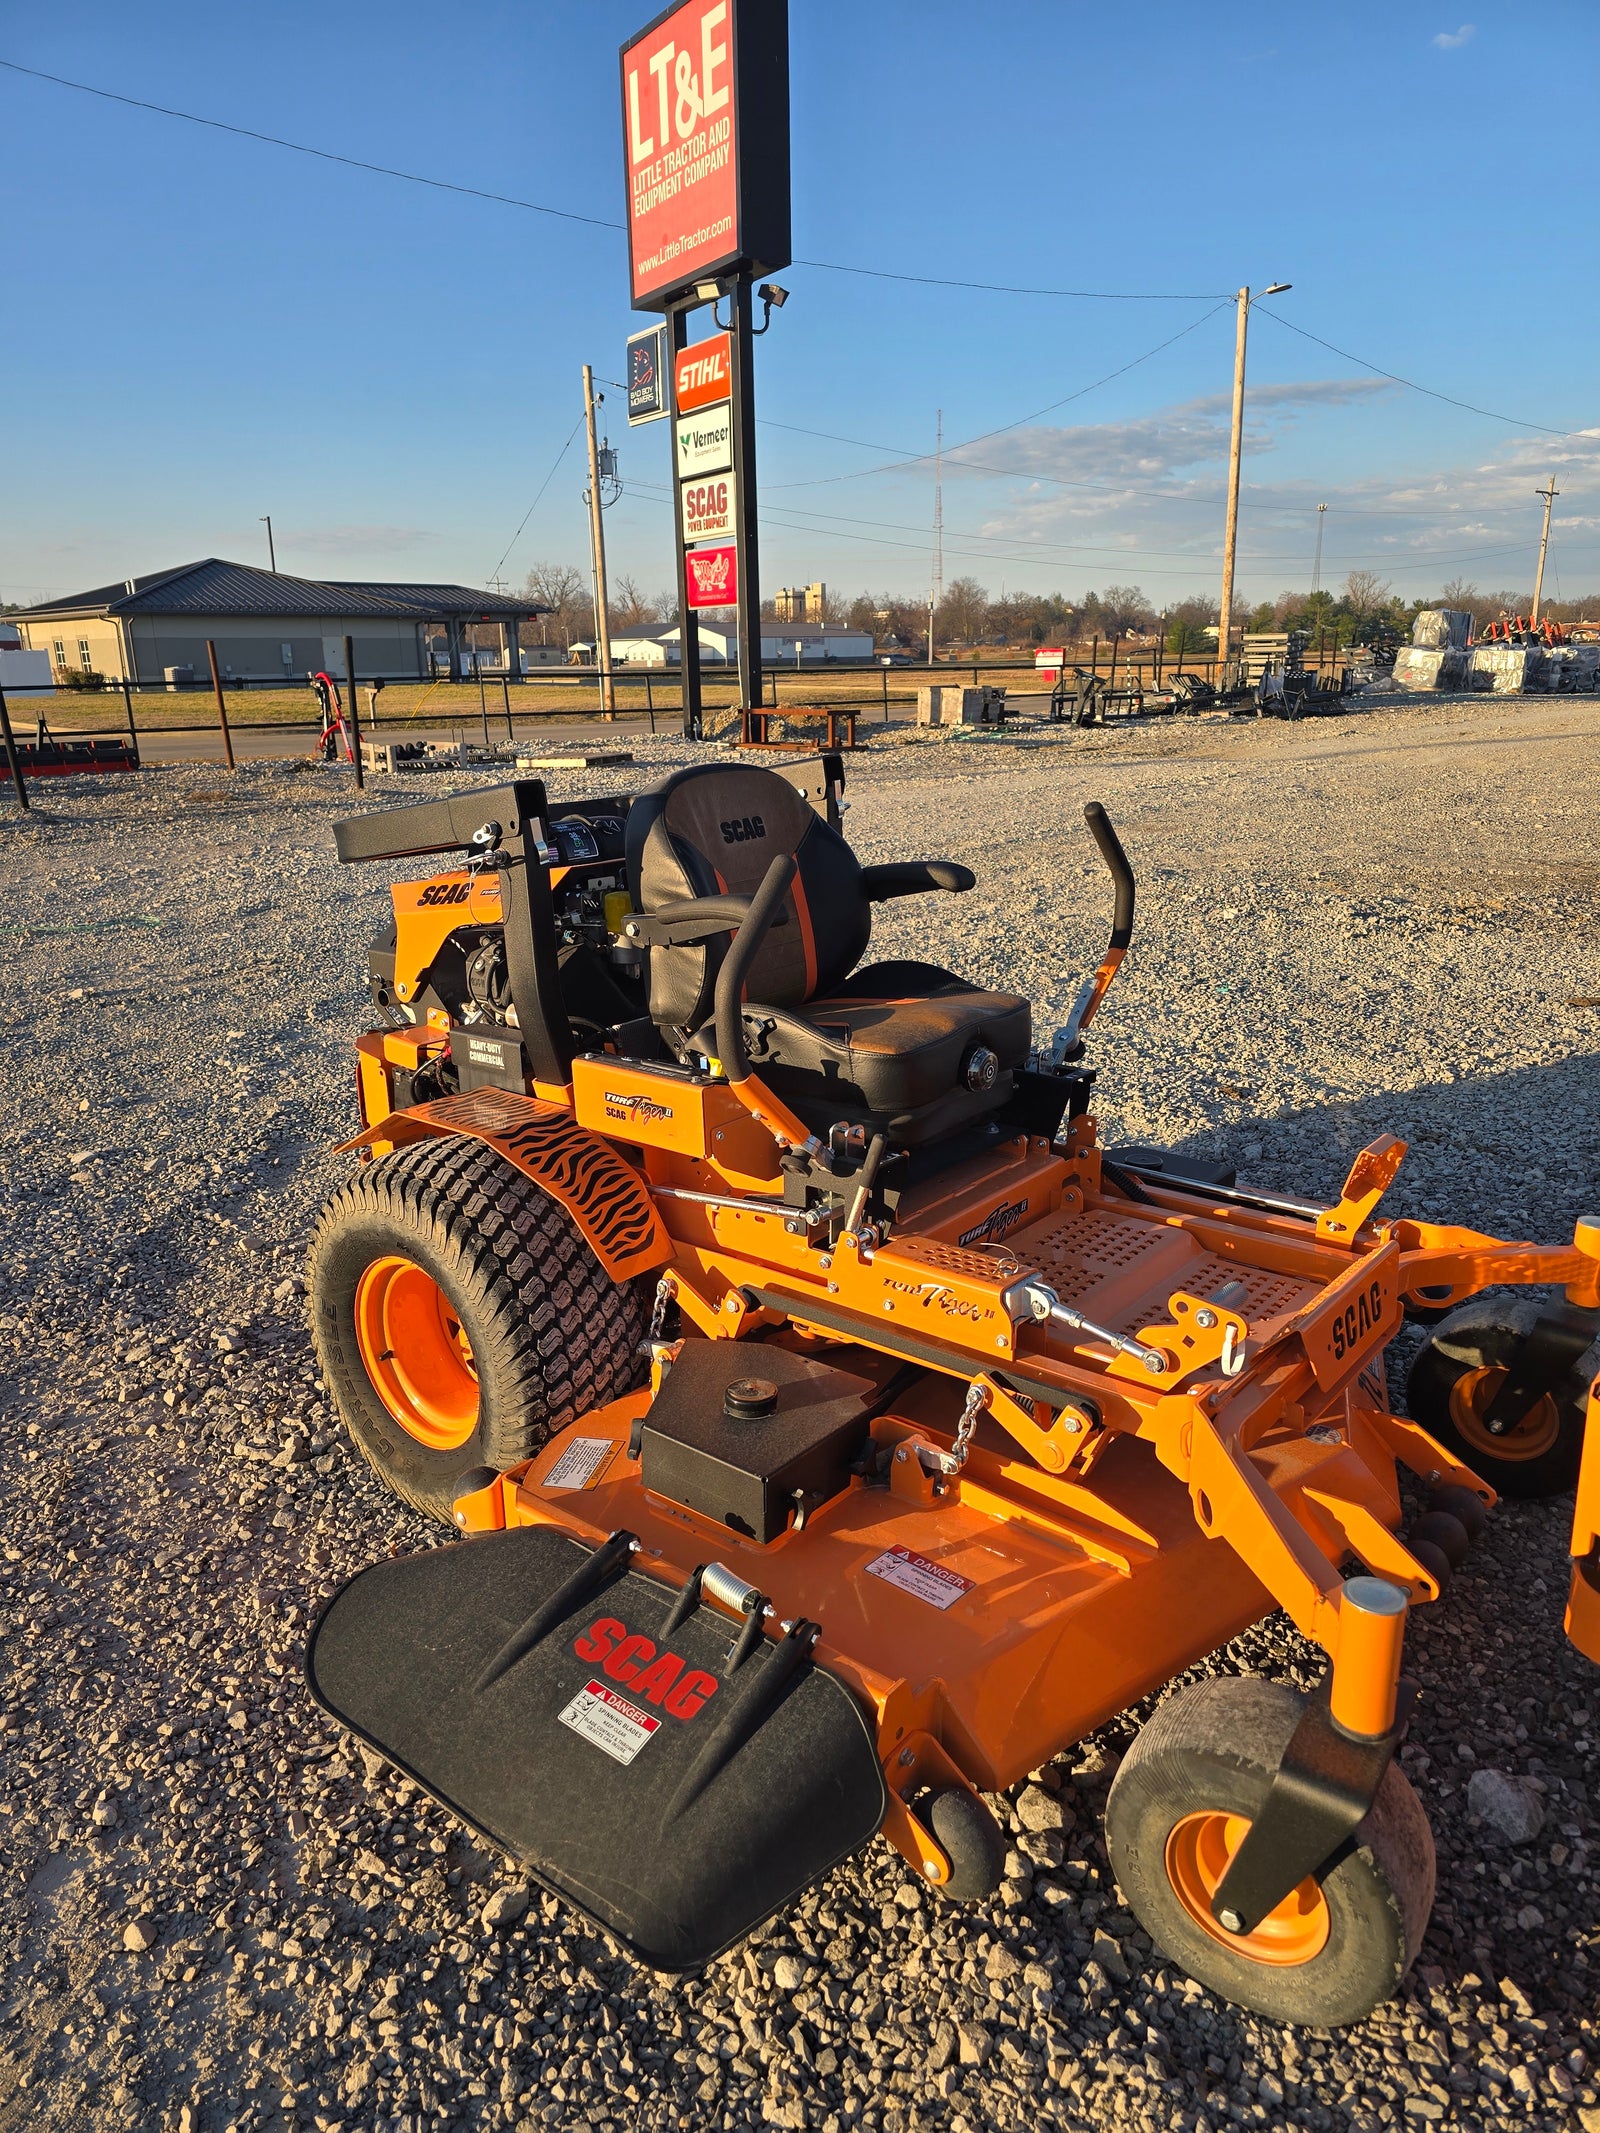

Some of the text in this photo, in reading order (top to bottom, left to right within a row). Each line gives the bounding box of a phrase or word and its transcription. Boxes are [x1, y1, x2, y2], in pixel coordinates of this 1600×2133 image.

[629, 0, 729, 165] LT&E
[633, 117, 730, 195] LITTLE TRACTOR AND
[635, 142, 730, 218] EQUIPMENT COMPANY
[638, 216, 732, 275] www.LittleTractor.com
[679, 353, 725, 393] STIHL
[630, 386, 654, 400] BAD BOY
[693, 427, 729, 449] Vermeer
[687, 482, 728, 520] SCAG
[688, 515, 728, 533] POWER EQUIPMENT
[720, 815, 767, 844] SCAG
[417, 882, 475, 906] SCAG
[469, 1039, 502, 1054] HEAVY-DUTY
[469, 1051, 505, 1067] COMMERCIAL
[606, 1093, 634, 1106] TURF
[628, 1096, 665, 1126] Tiger
[606, 1106, 626, 1121] SCAG
[1332, 1281, 1382, 1360] SCAG
[911, 1567, 953, 1591] SPINNING BLADES
[914, 1558, 965, 1587] DANGER
[574, 1617, 719, 1721] SCAG
[597, 1707, 643, 1739] SPINNING BLADES
[606, 1694, 648, 1726] DANGER
[586, 1725, 603, 1738] OBJECTS
[603, 1736, 612, 1744] CAN
[596, 1725, 615, 1739] CONTACT
[618, 1739, 635, 1753] THROWN
[603, 1720, 627, 1738] KEEP CLEAR
